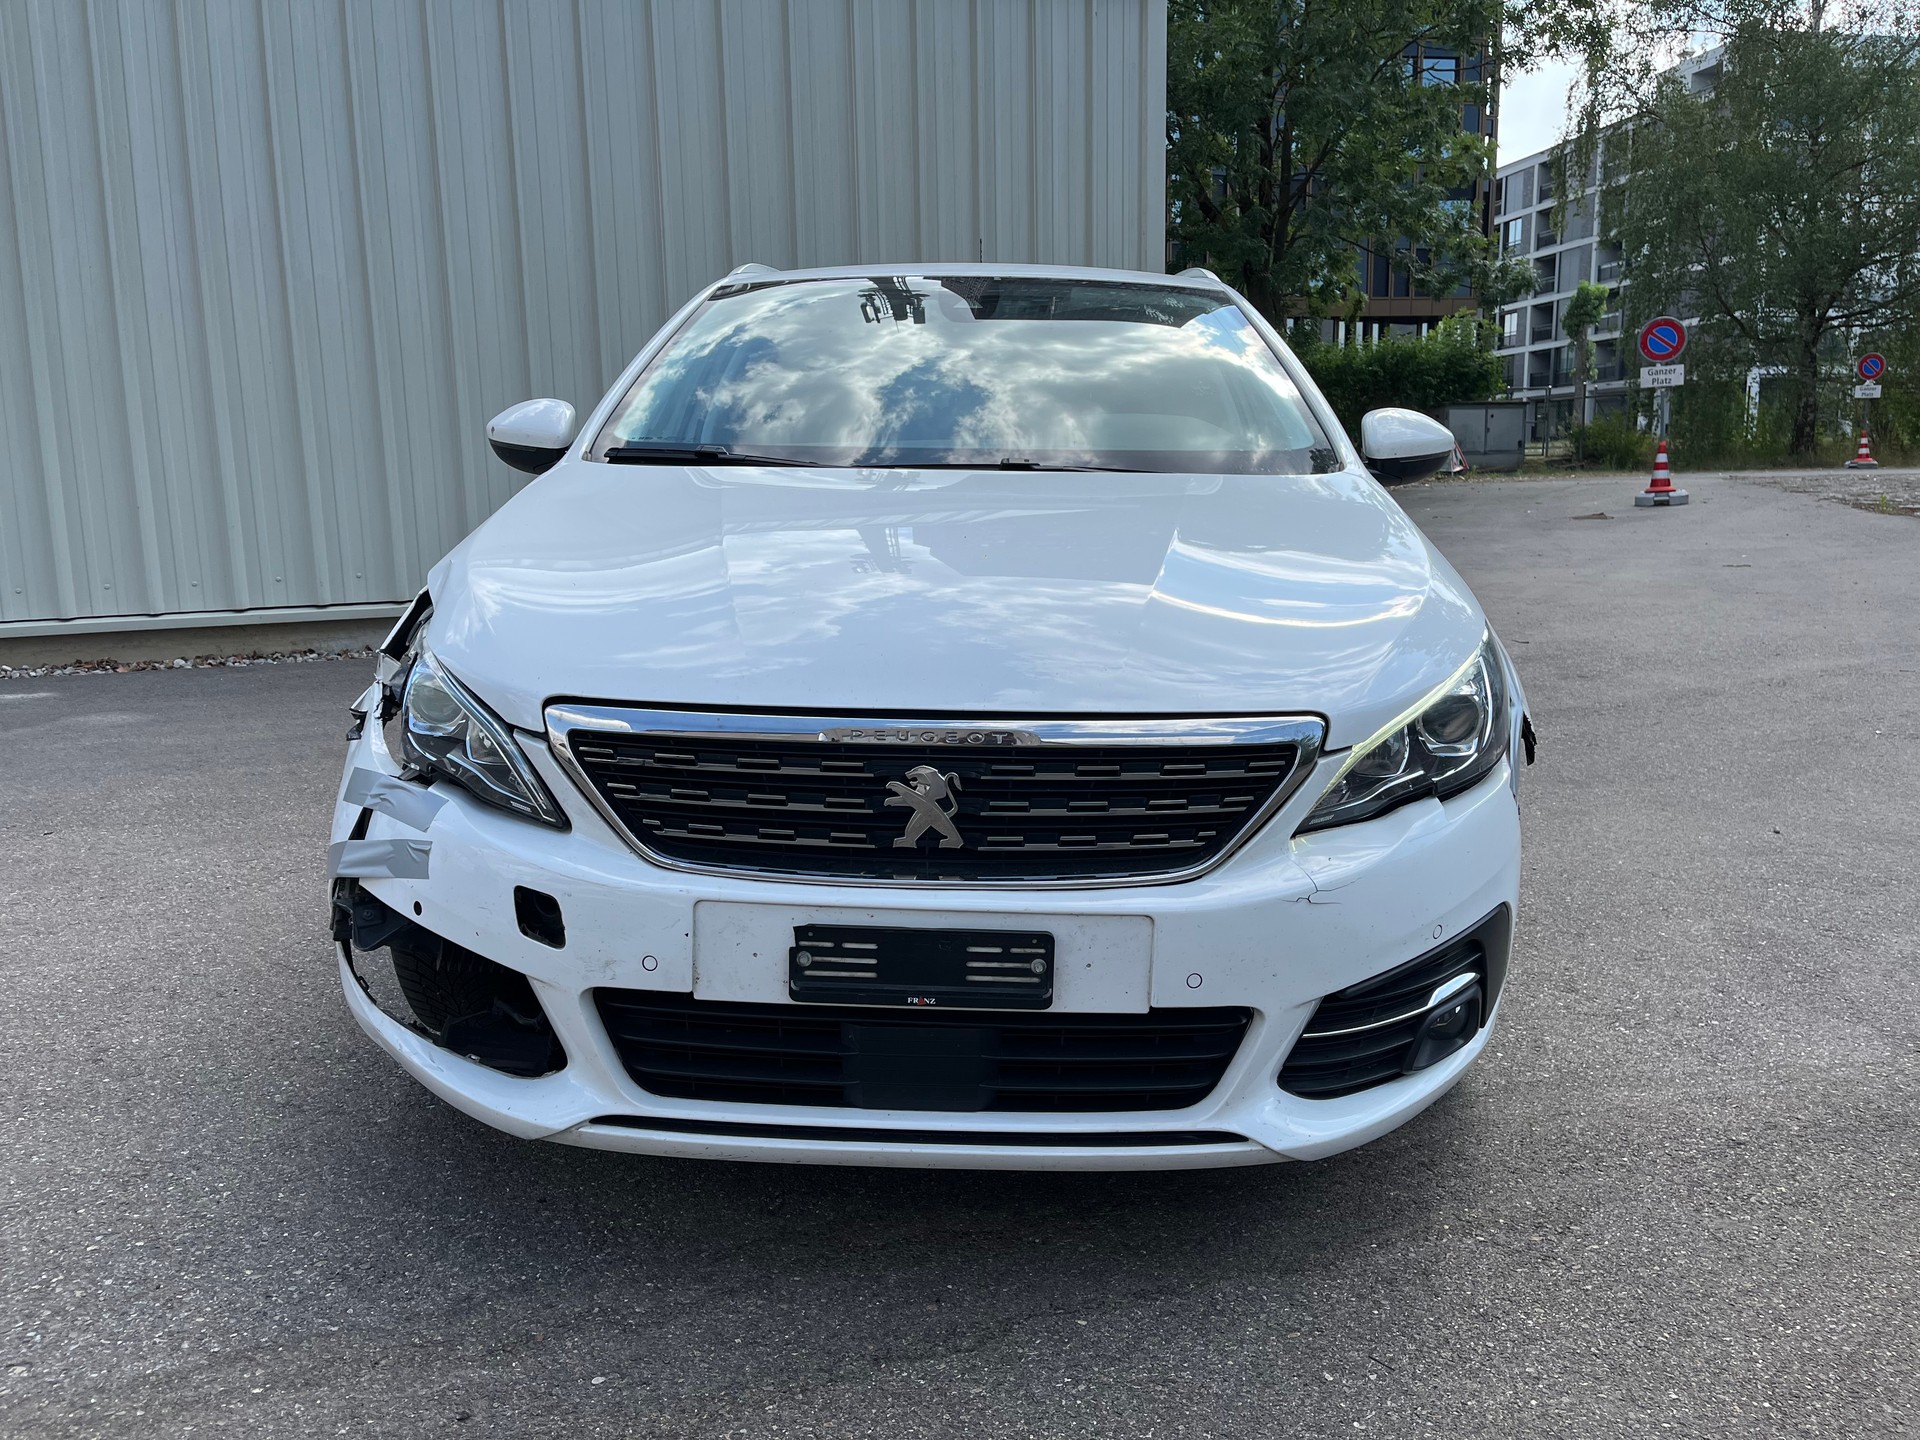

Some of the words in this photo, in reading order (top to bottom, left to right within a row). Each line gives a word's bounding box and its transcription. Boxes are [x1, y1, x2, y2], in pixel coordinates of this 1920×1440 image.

[1647, 368, 1677, 376] Ganzer
[1651, 377, 1672, 385] Platz
[850, 729, 1008, 744] PEUGEOT
